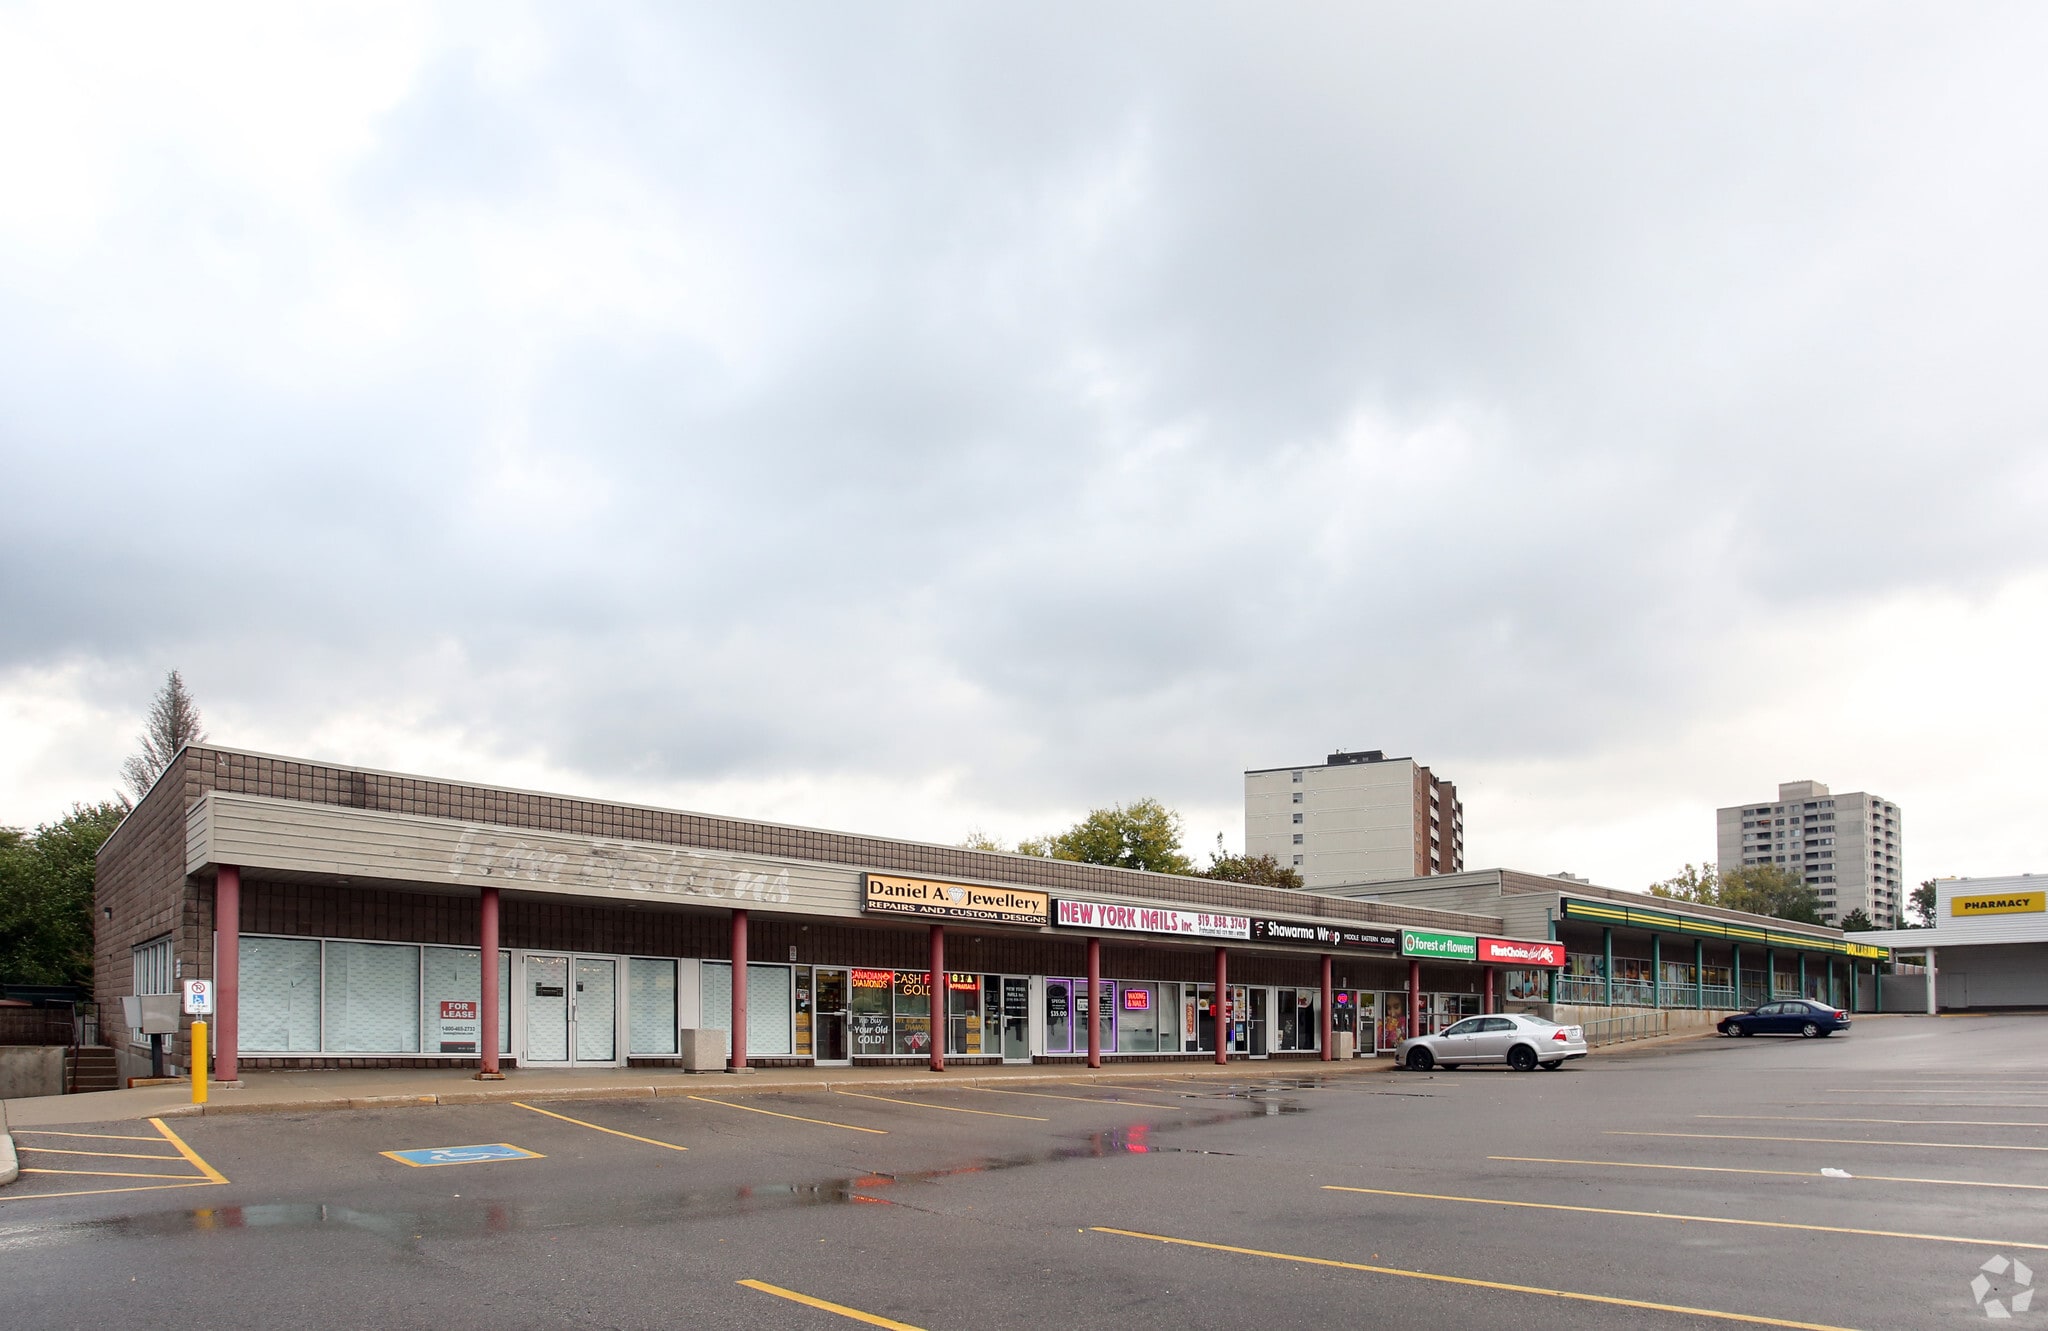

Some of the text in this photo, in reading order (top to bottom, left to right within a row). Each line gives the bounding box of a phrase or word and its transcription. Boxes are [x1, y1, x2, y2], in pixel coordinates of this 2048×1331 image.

[870, 881, 1040, 914] Daniel A. Jewellery
[1964, 898, 2030, 909] PHARMACY
[869, 900, 1047, 923] REPAIRS AND CUSTOM DESIGNS
[1060, 902, 1094, 924] NEW
[1097, 905, 1137, 928] YORK
[1141, 909, 1178, 931] NAILS
[1268, 921, 1314, 940] Shawarma
[1361, 935, 1379, 943] EASTERN
[1415, 936, 1474, 954] forest of flowers
[851, 970, 883, 980] CANADIAN
[894, 972, 921, 984] CASH
[853, 979, 888, 988] DIAMONDS
[443, 1010, 475, 1018] LEASE
[870, 1016, 883, 1025] Buy
[854, 1025, 888, 1034] Your Old
[858, 1035, 885, 1044] GOLD!
